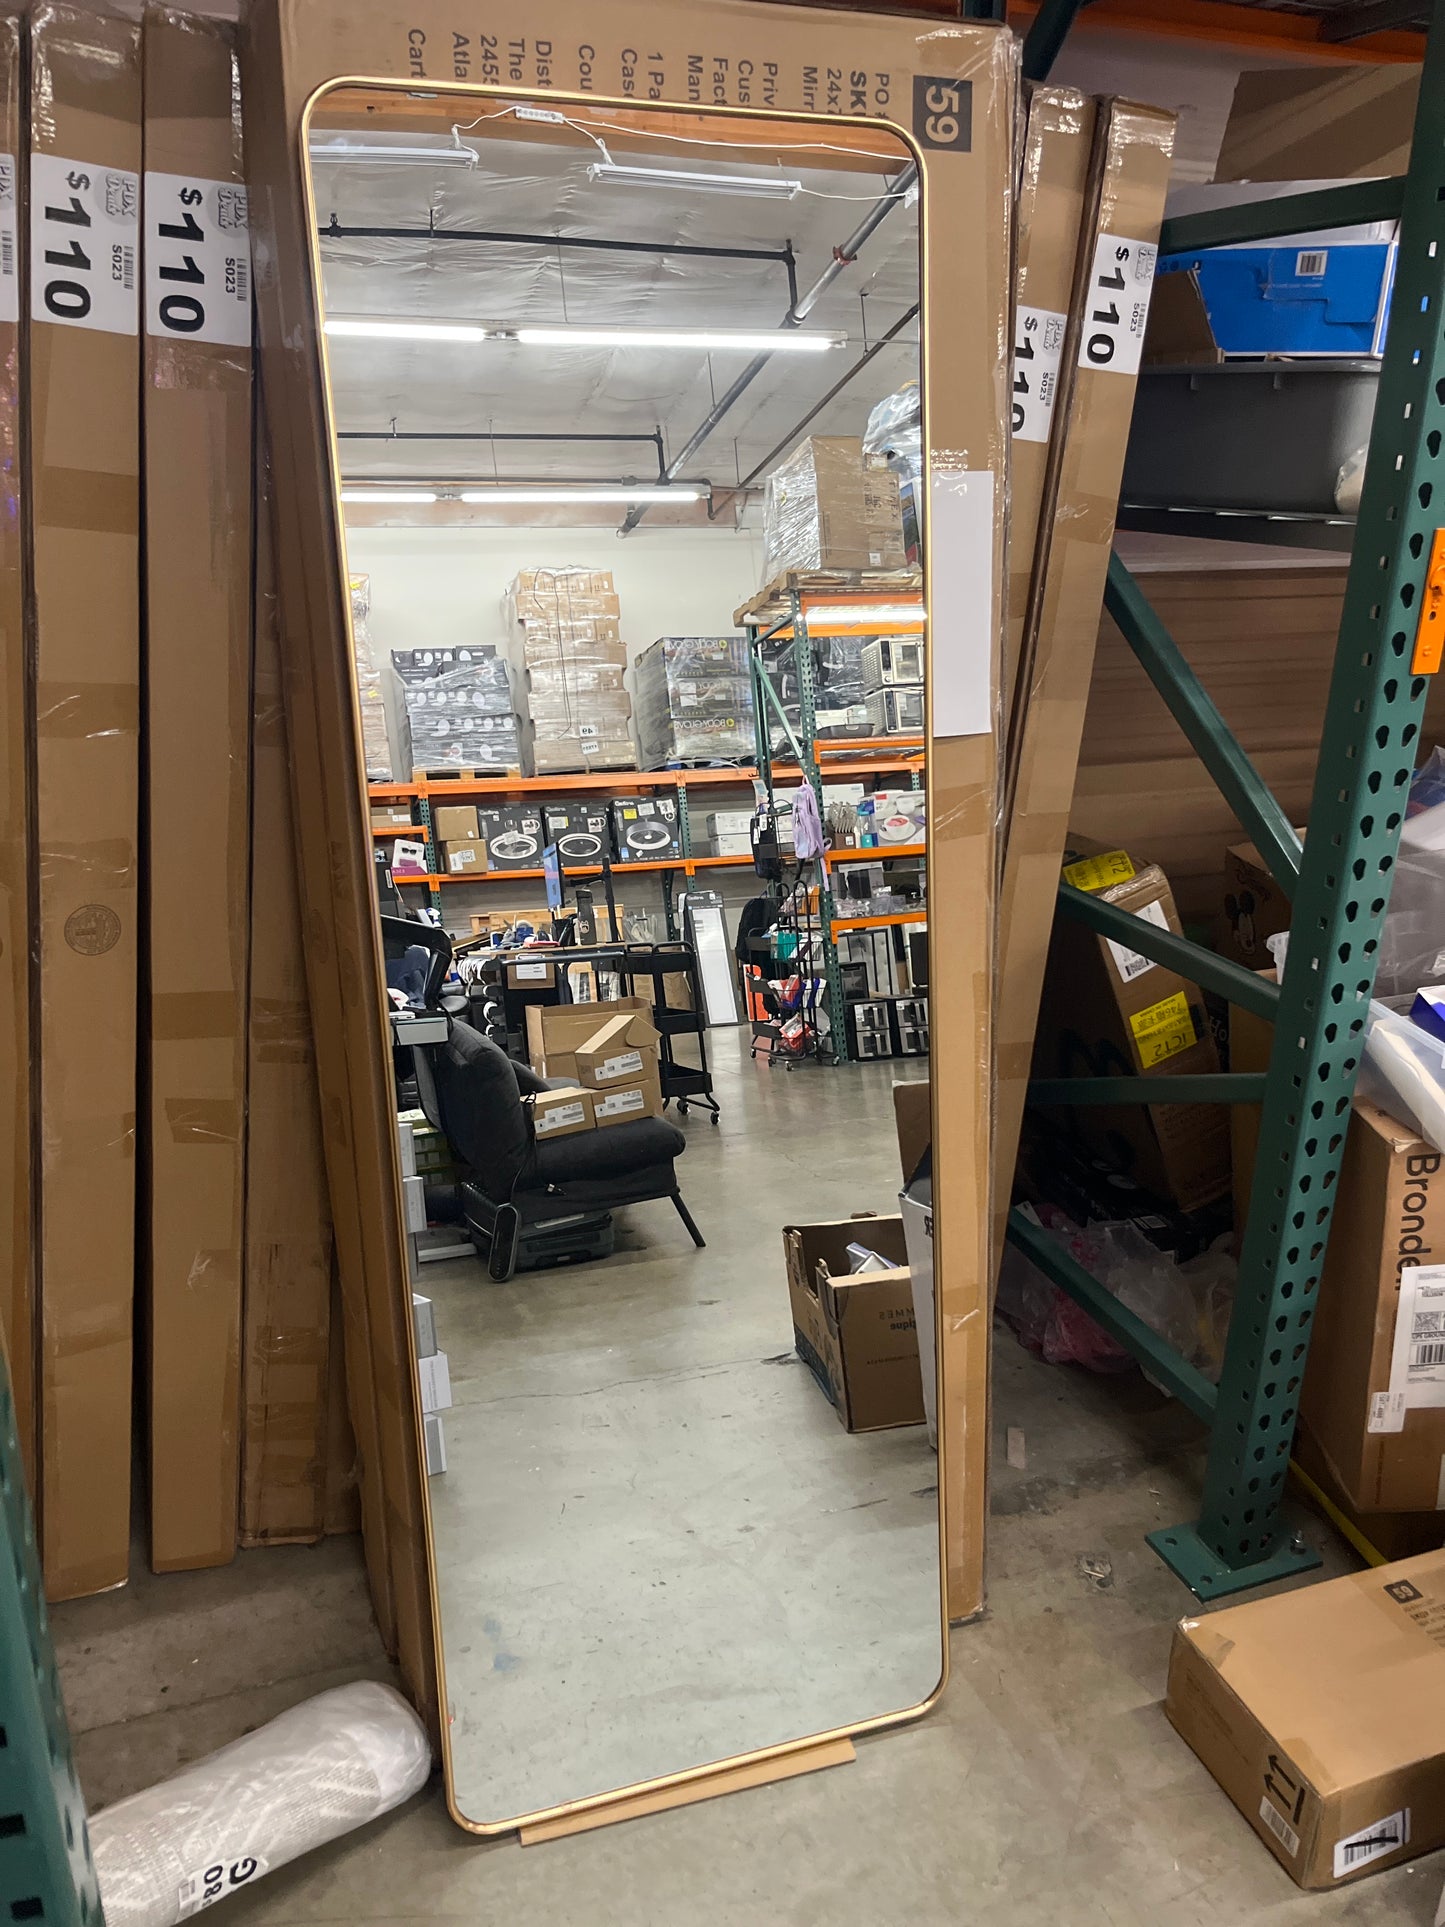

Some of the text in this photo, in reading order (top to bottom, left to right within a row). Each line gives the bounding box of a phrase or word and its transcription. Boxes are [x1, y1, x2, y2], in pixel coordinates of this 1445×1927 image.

[408, 28, 426, 79] Cart
[452, 32, 472, 84] Atla
[508, 38, 525, 81] The
[535, 40, 552, 88] Dist
[578, 44, 595, 90] Cou
[648, 52, 664, 100] 1 Pa
[687, 55, 703, 101] Man
[713, 57, 728, 105] Fact
[763, 62, 778, 106] Priv
[802, 66, 818, 110] Mirr
[875, 73, 890, 105] PO
[925, 85, 959, 143] 59
[122, 177, 137, 218] PDX
[234, 190, 249, 230] PDX
[44, 170, 92, 319] $110
[112, 244, 123, 281] S023
[158, 187, 205, 333] $110
[225, 257, 236, 294] S023
[1086, 245, 1130, 364] $110
[1130, 302, 1141, 333] S023
[1039, 372, 1050, 401] S023
